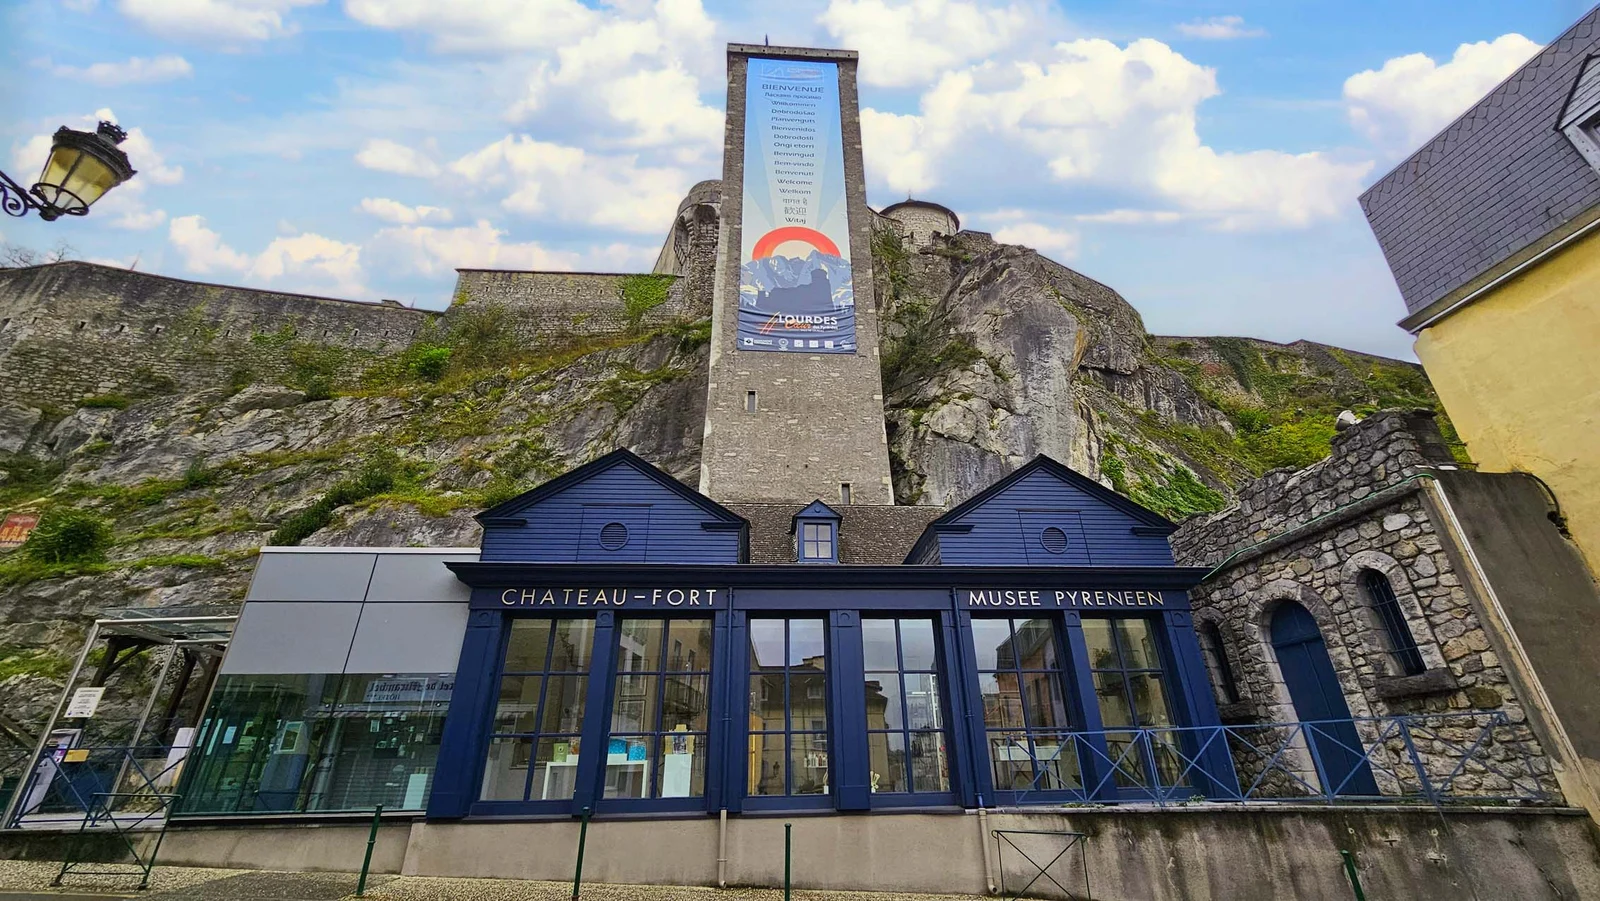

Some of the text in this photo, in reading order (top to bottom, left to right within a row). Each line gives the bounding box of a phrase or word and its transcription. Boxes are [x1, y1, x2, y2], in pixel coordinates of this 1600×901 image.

[762, 83, 824, 93] BIENVENUE
[773, 141, 792, 149] Ongi
[778, 314, 838, 325] LOURDES
[969, 590, 1164, 606] MUSEE PYRENEEN
